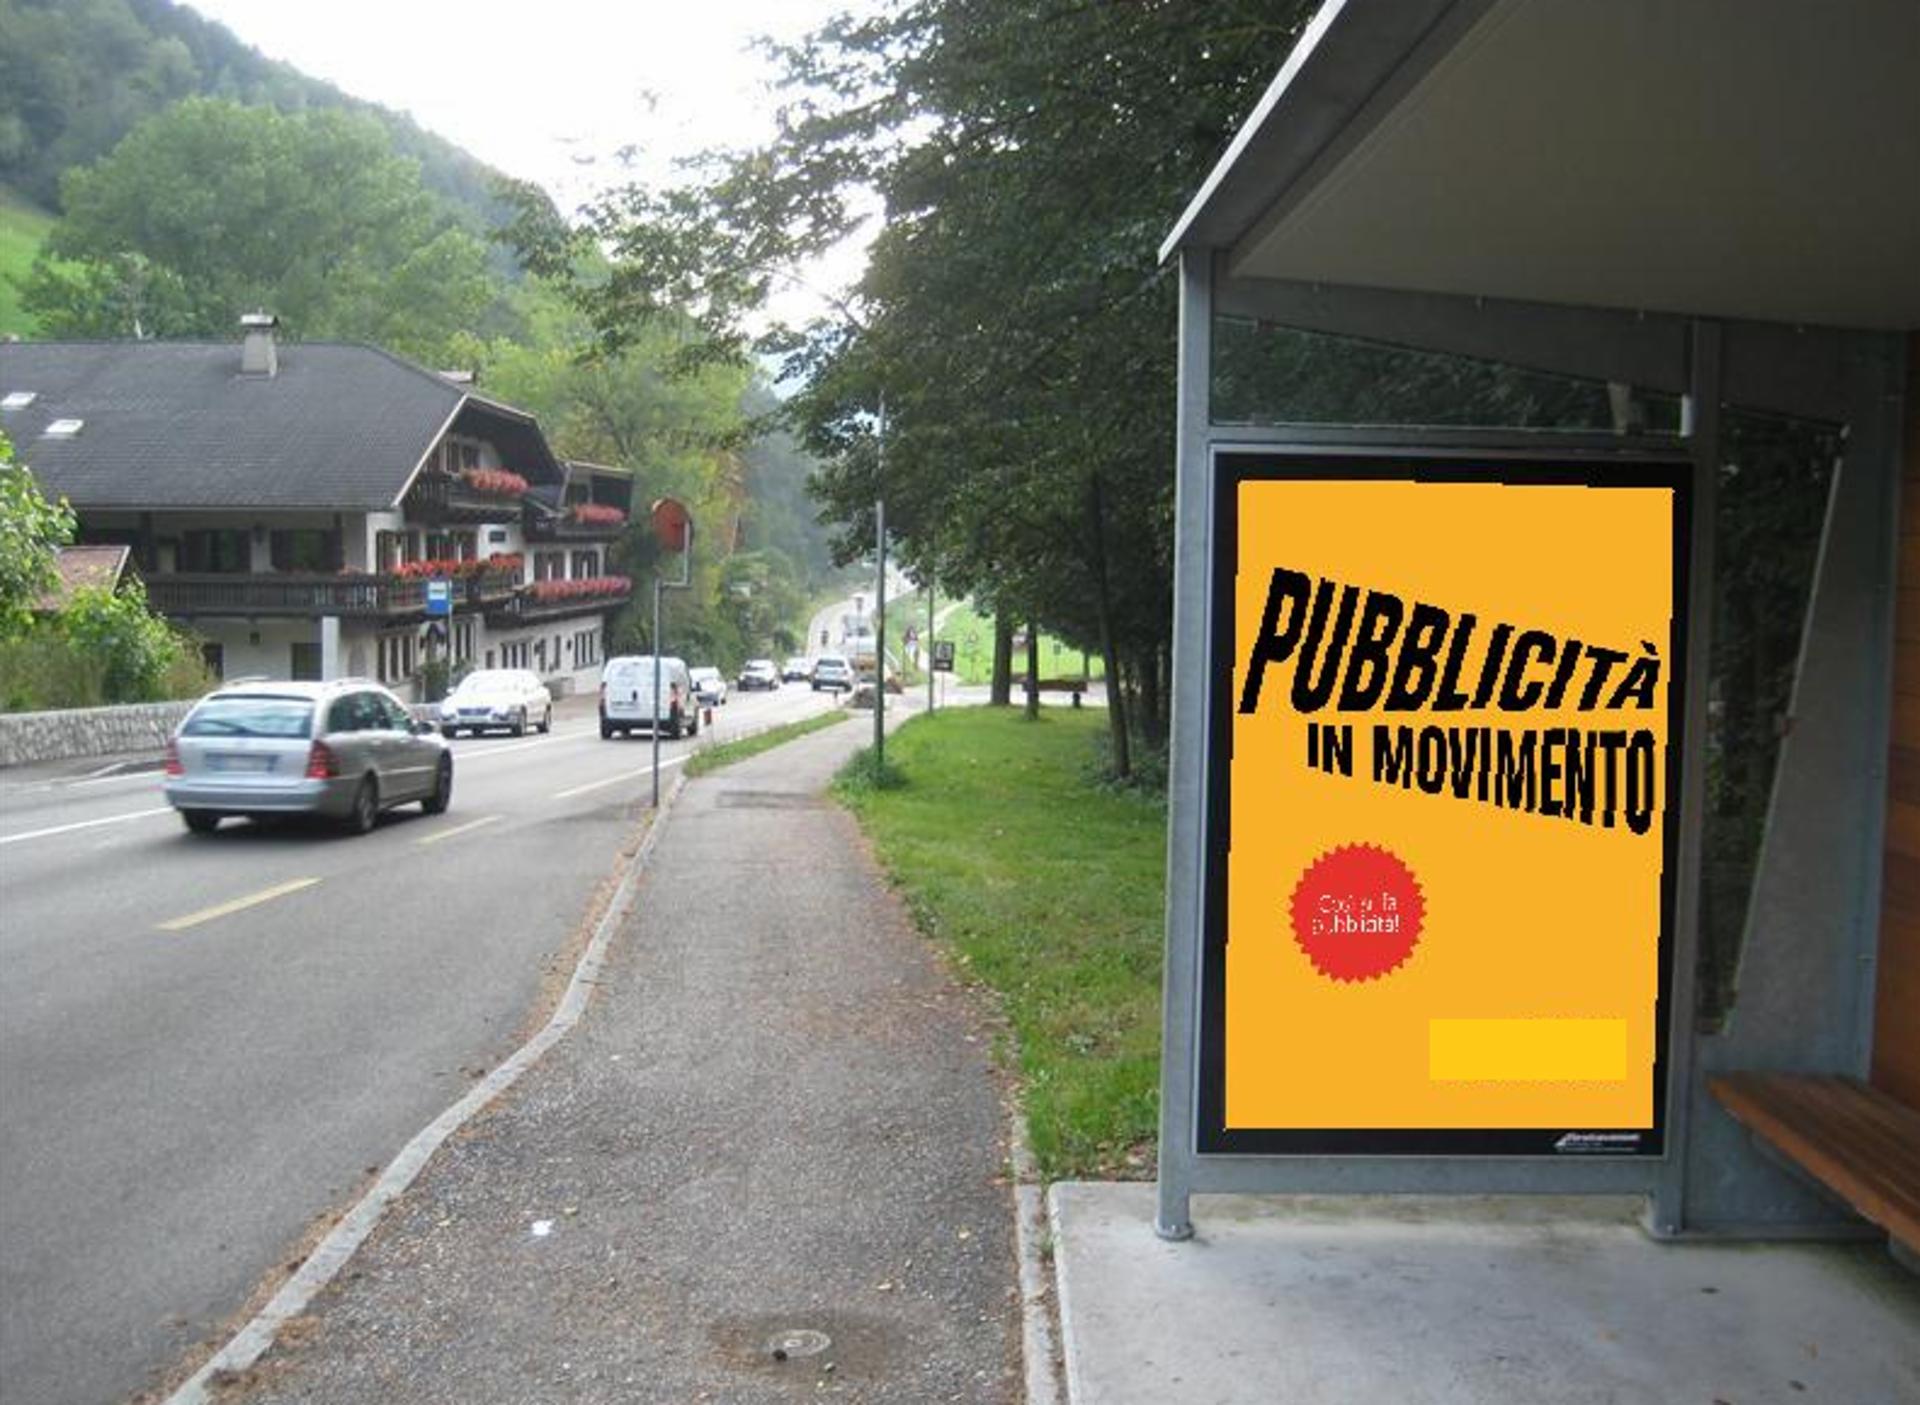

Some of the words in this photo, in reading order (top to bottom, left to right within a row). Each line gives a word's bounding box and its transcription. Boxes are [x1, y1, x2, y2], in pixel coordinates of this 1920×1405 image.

[1238, 567, 1661, 714] PUBBLICITÀ
[1307, 722, 1353, 777] IN
[1372, 724, 1656, 835] MOVIMENTO
